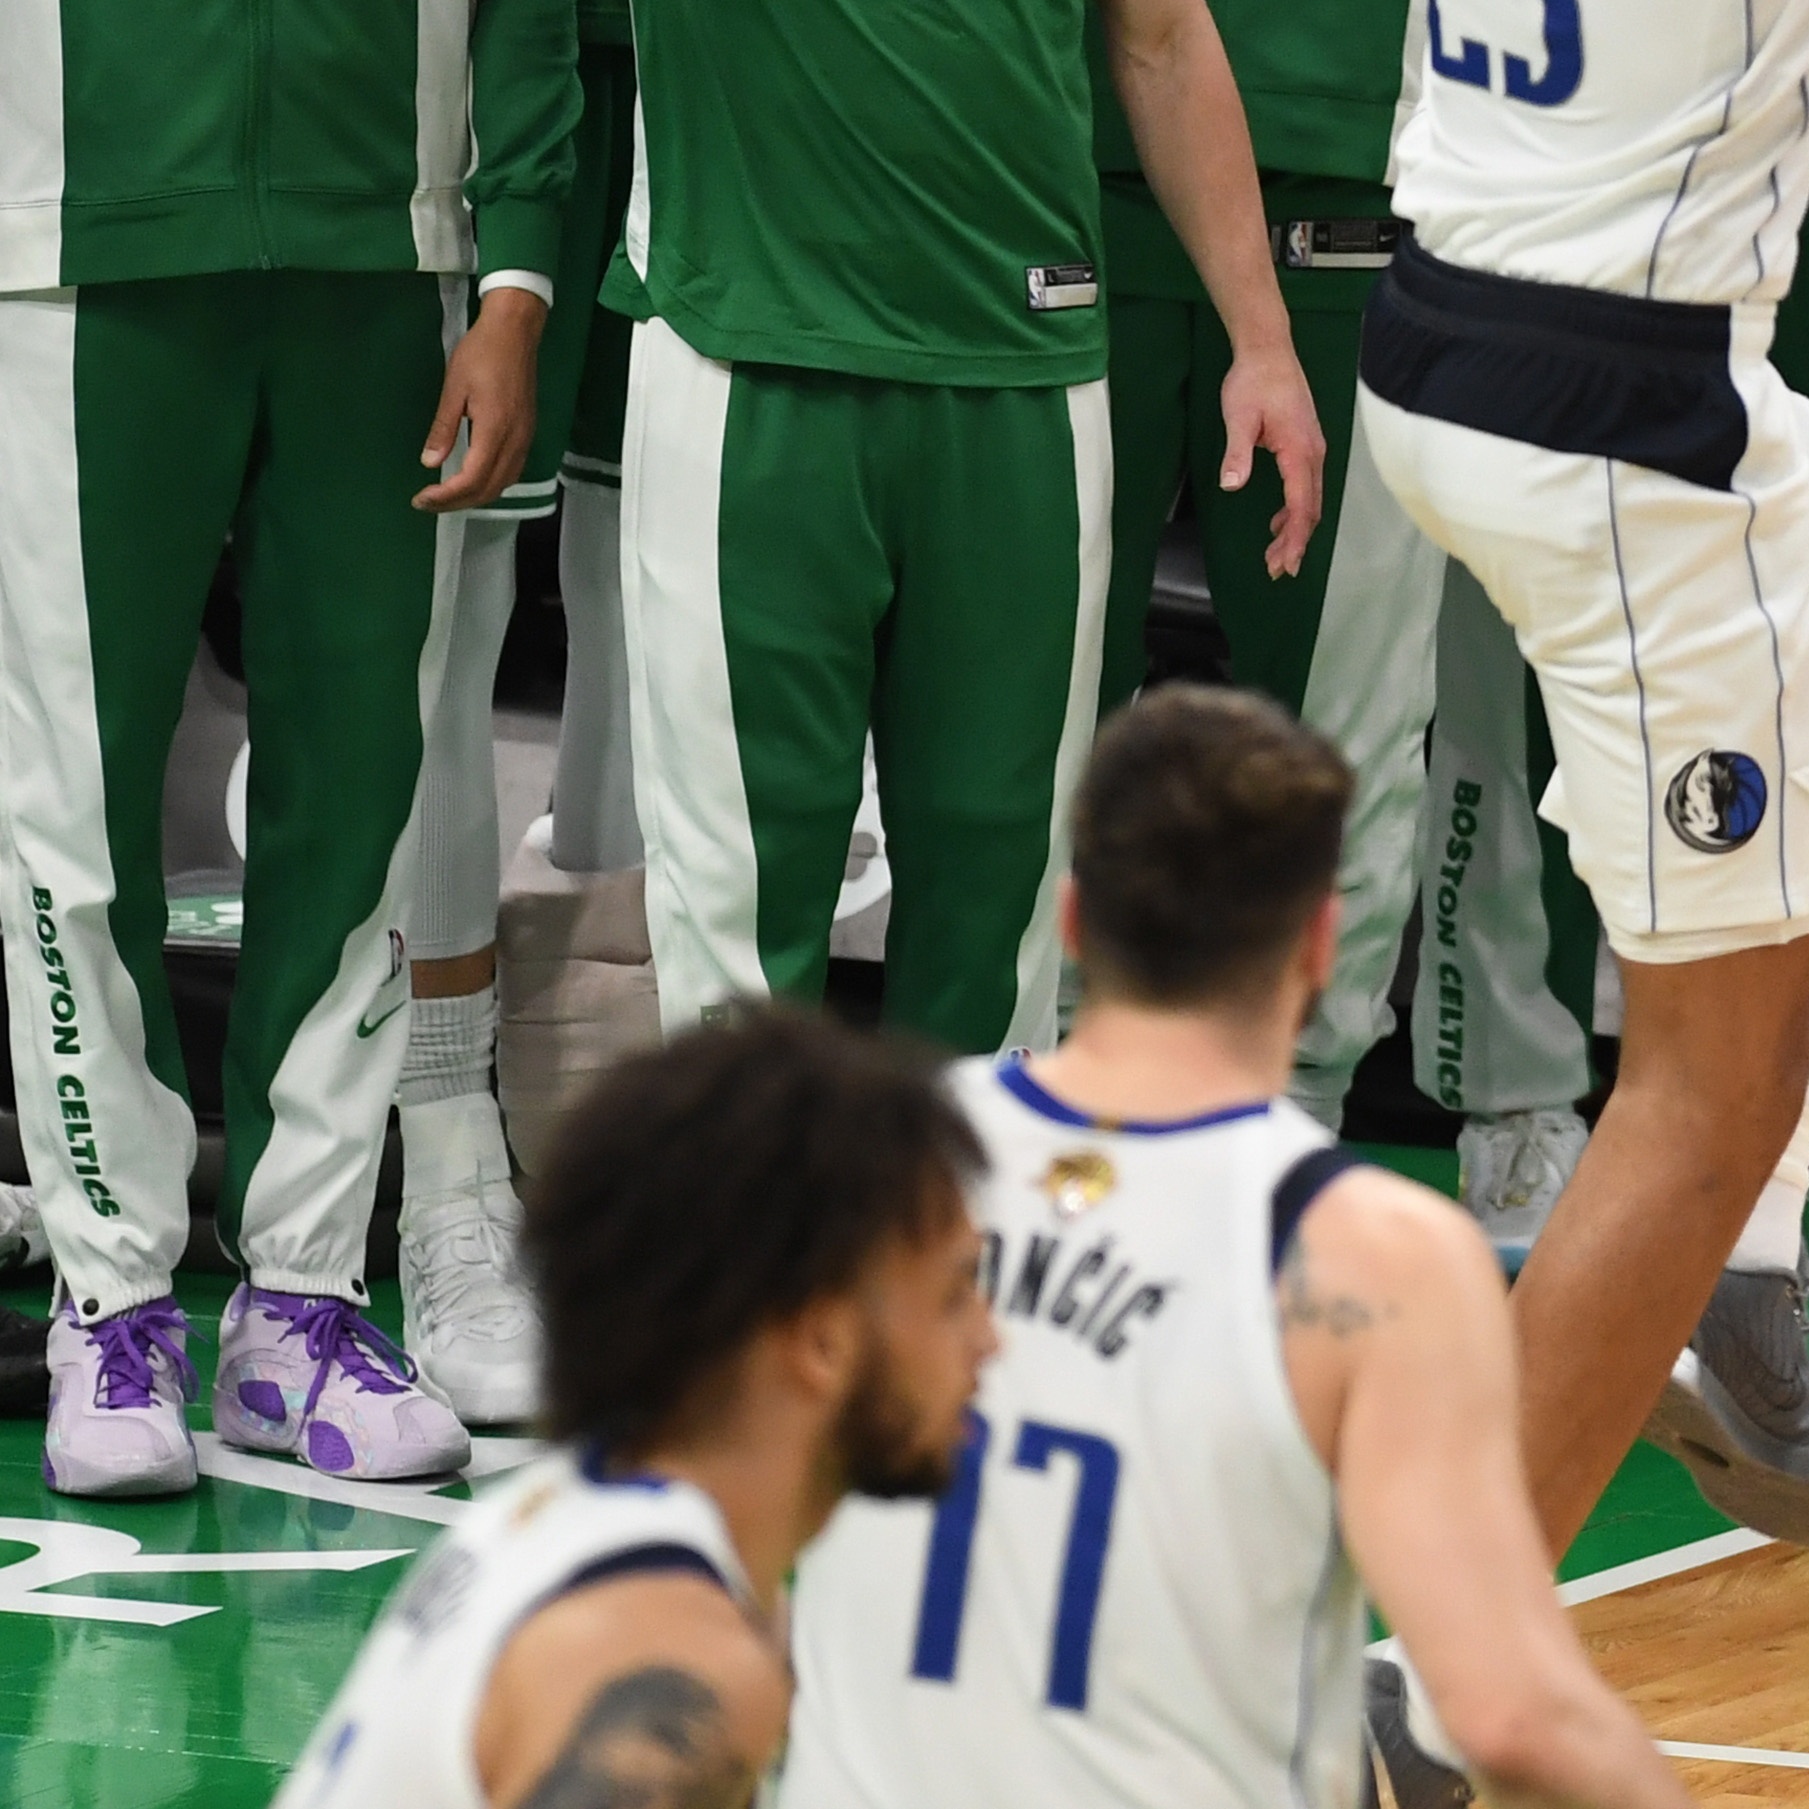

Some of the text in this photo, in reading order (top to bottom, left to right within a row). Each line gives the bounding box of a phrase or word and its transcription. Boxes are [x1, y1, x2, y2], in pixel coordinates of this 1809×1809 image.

[34, 888, 121, 1218] BOSTON CELTICS
[1437, 779, 1482, 1110] BOSTON CELTICS
